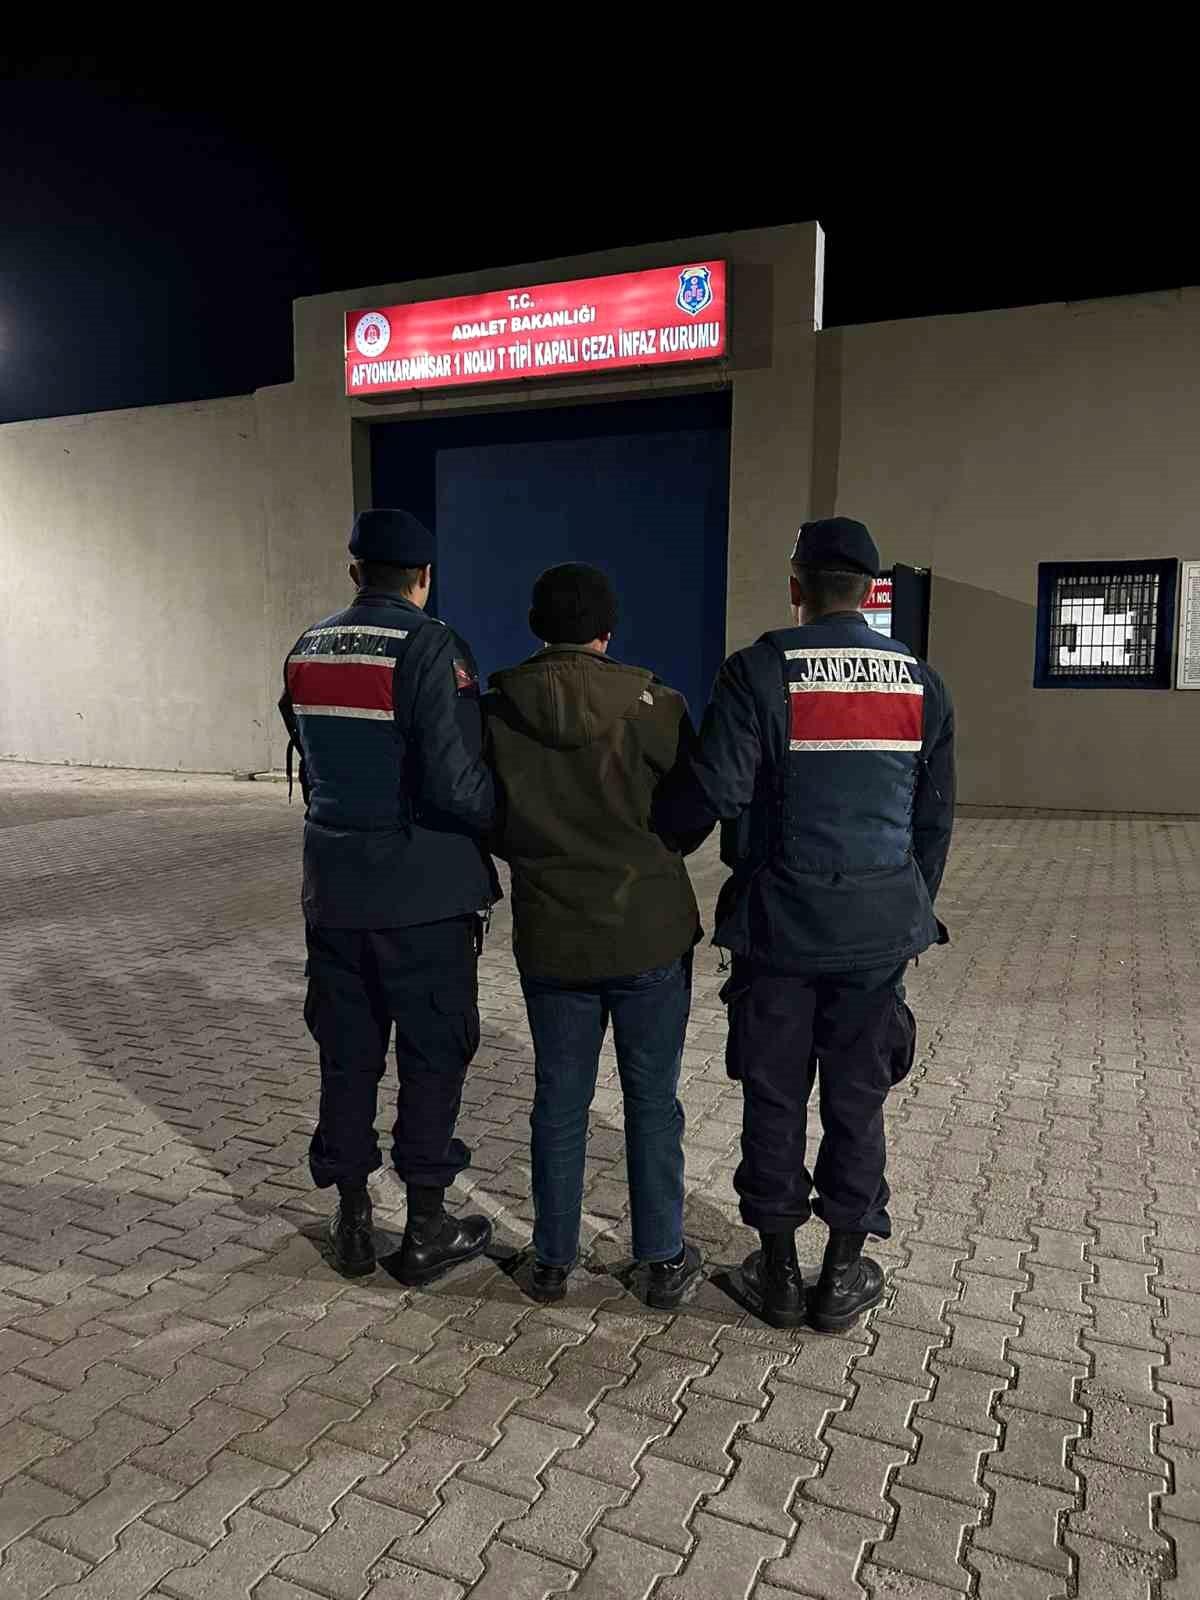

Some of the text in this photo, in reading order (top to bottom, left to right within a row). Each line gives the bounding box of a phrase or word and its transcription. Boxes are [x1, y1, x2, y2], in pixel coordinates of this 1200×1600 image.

[507, 293, 535, 311] T.C.
[451, 304, 596, 341] ADALET BAKANLIĞI
[454, 352, 461, 376] 1
[463, 348, 495, 375] NOLU
[497, 346, 506, 371] T
[508, 337, 532, 369] TİPİ
[534, 338, 579, 367] KAPALI
[581, 333, 616, 361] CEZA
[618, 327, 657, 358] İNFAZ
[659, 321, 720, 353] KURUMU
[801, 657, 913, 684] JANDARMA
